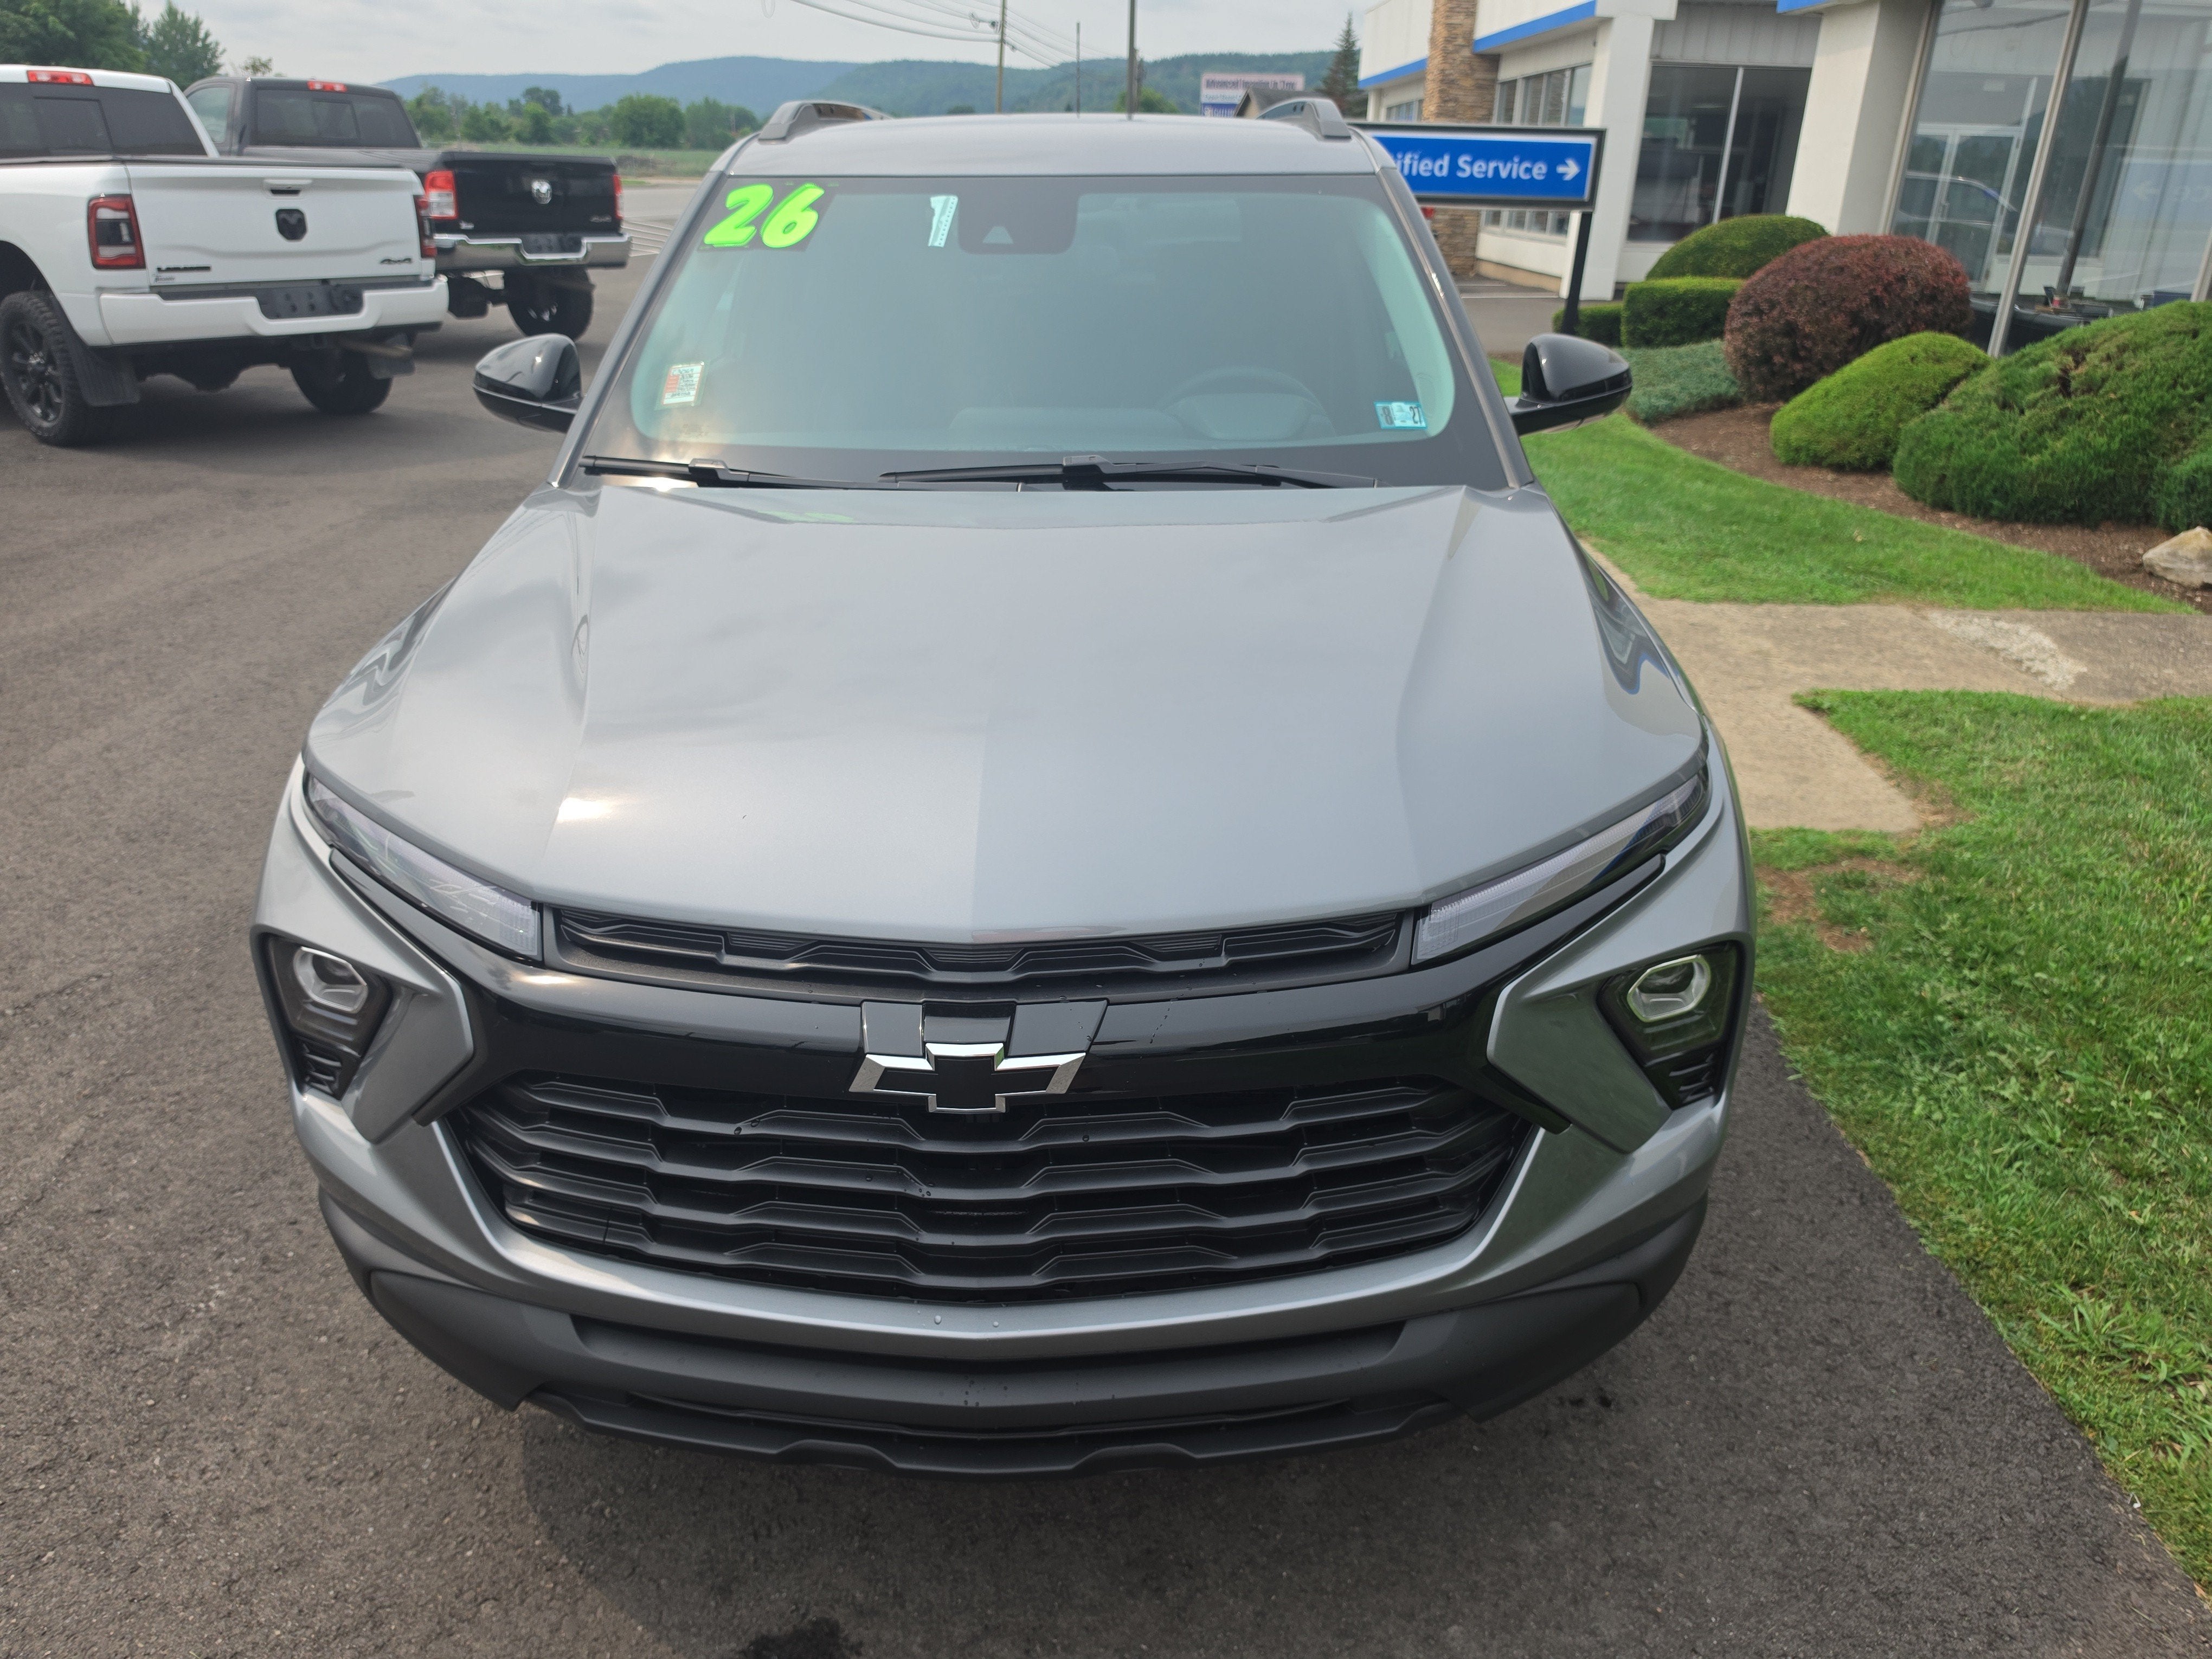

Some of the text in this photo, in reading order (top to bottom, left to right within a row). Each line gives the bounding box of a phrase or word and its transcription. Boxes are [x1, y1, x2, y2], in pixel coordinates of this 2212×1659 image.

[1395, 151, 1548, 181] ified Service
[704, 183, 825, 248] 26
